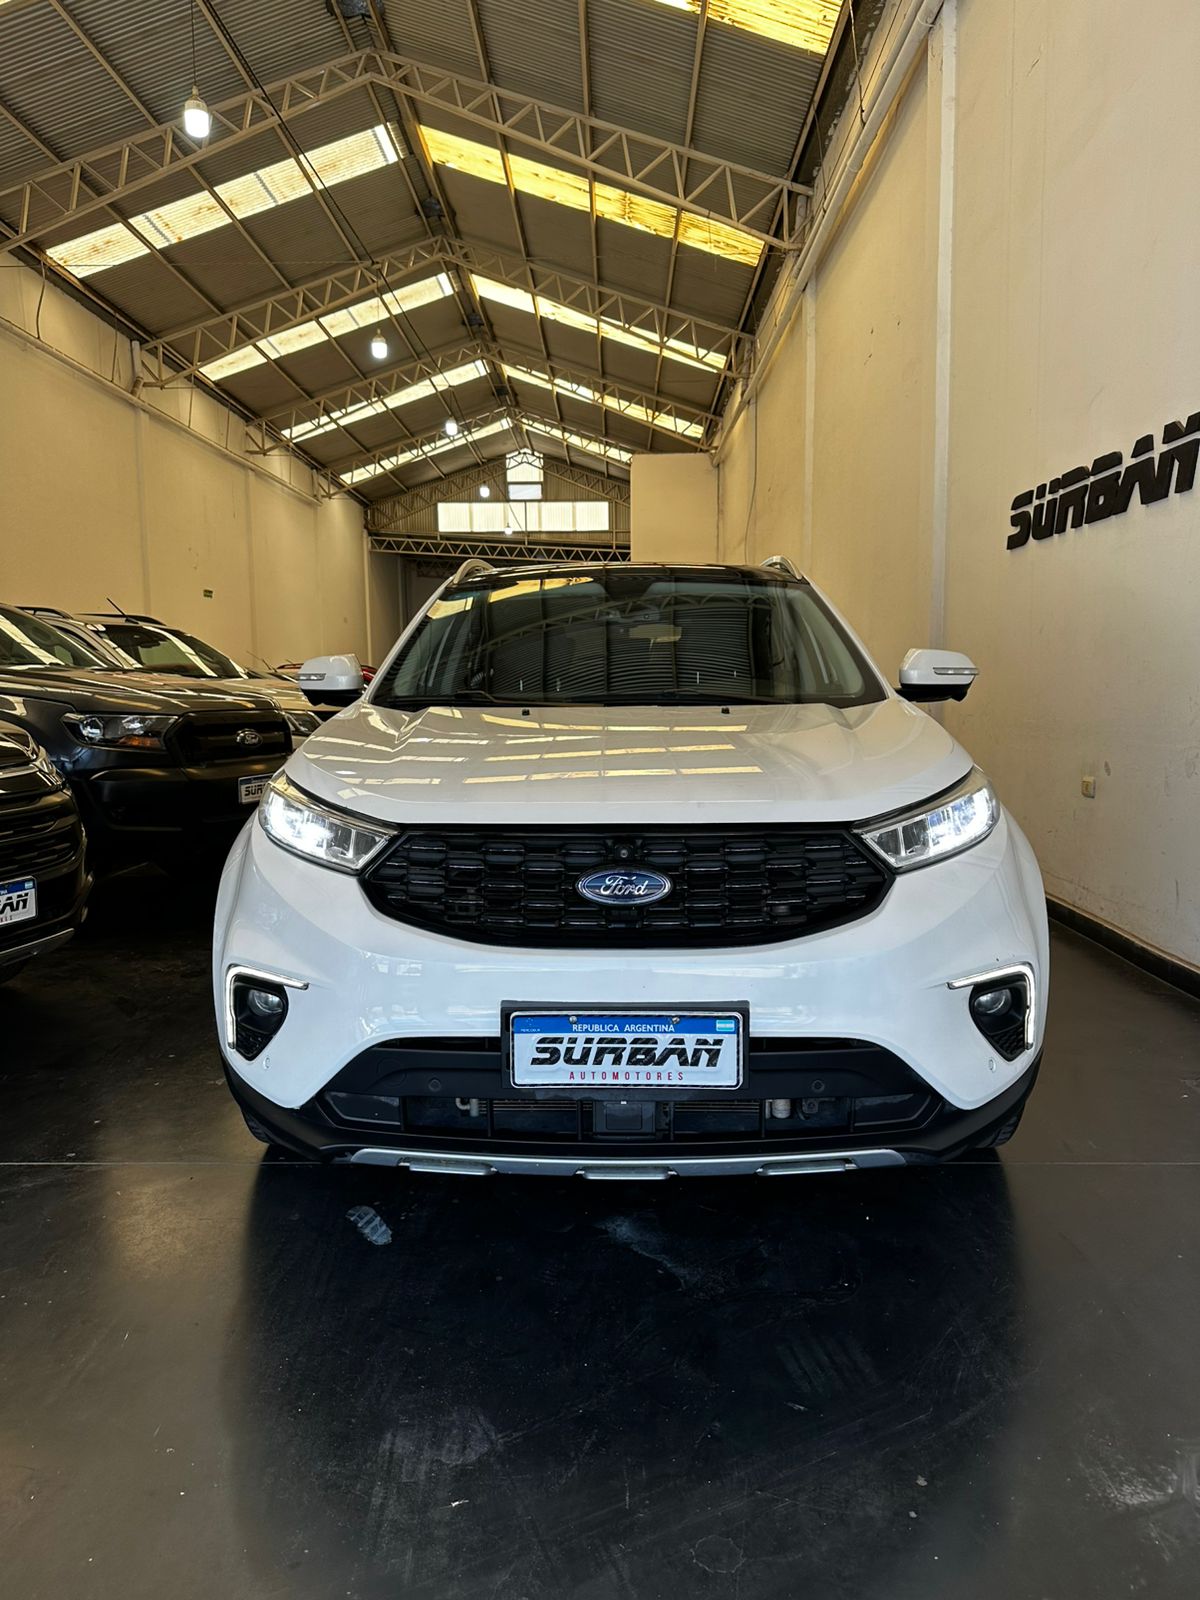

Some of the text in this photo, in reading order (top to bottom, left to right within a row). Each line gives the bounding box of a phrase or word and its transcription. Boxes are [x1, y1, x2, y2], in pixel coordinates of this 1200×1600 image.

[1007, 411, 1200, 550] SURBAN
[600, 875, 649, 896] Ford
[572, 1023, 675, 1033] REPUBLICA ARGENTINA
[530, 1037, 724, 1068] SURBAN
[569, 1071, 684, 1081] AUTOMOTORES
